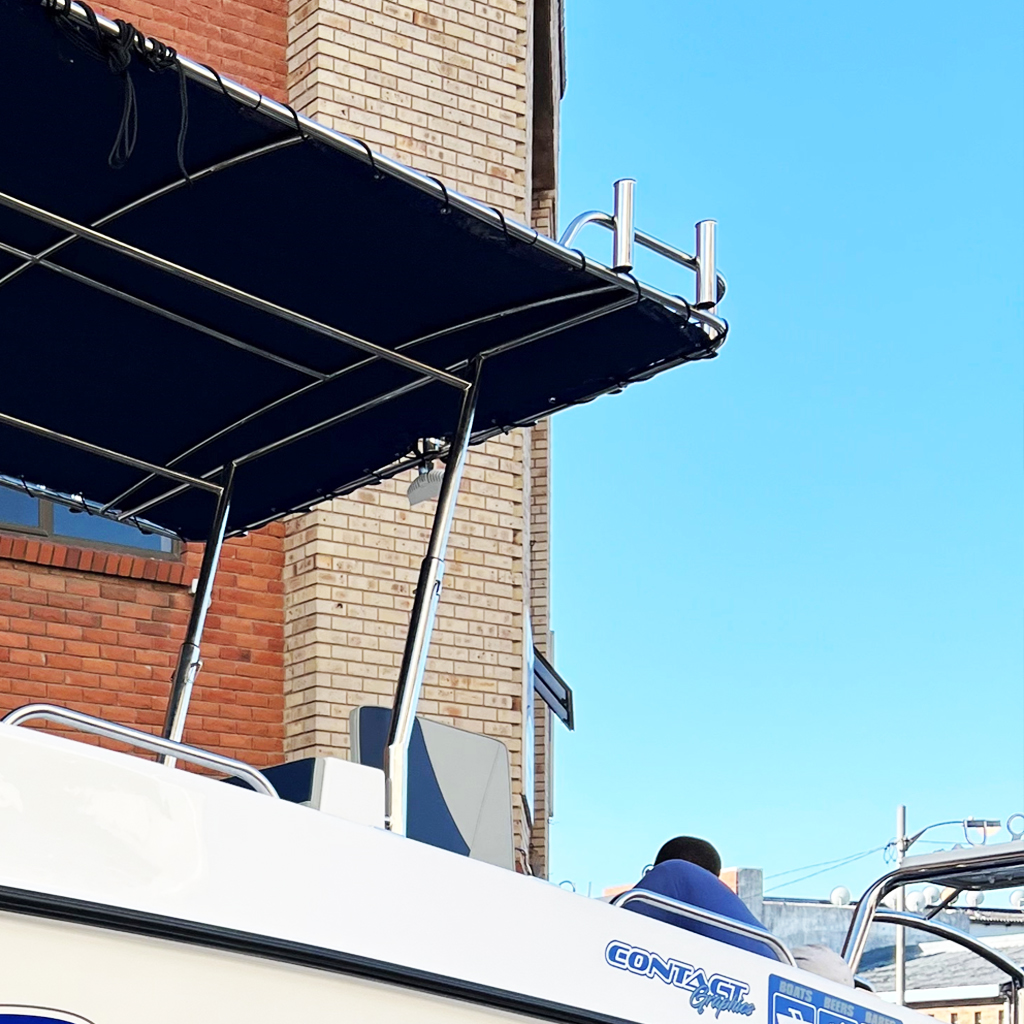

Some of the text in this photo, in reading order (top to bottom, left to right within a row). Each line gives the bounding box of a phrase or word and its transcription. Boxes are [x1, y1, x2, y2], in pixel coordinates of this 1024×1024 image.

[605, 939, 751, 1003] CONTACT
[689, 984, 756, 1020] Graphics
[778, 980, 814, 1002] BOATS
[823, 995, 855, 1018] BEERS
